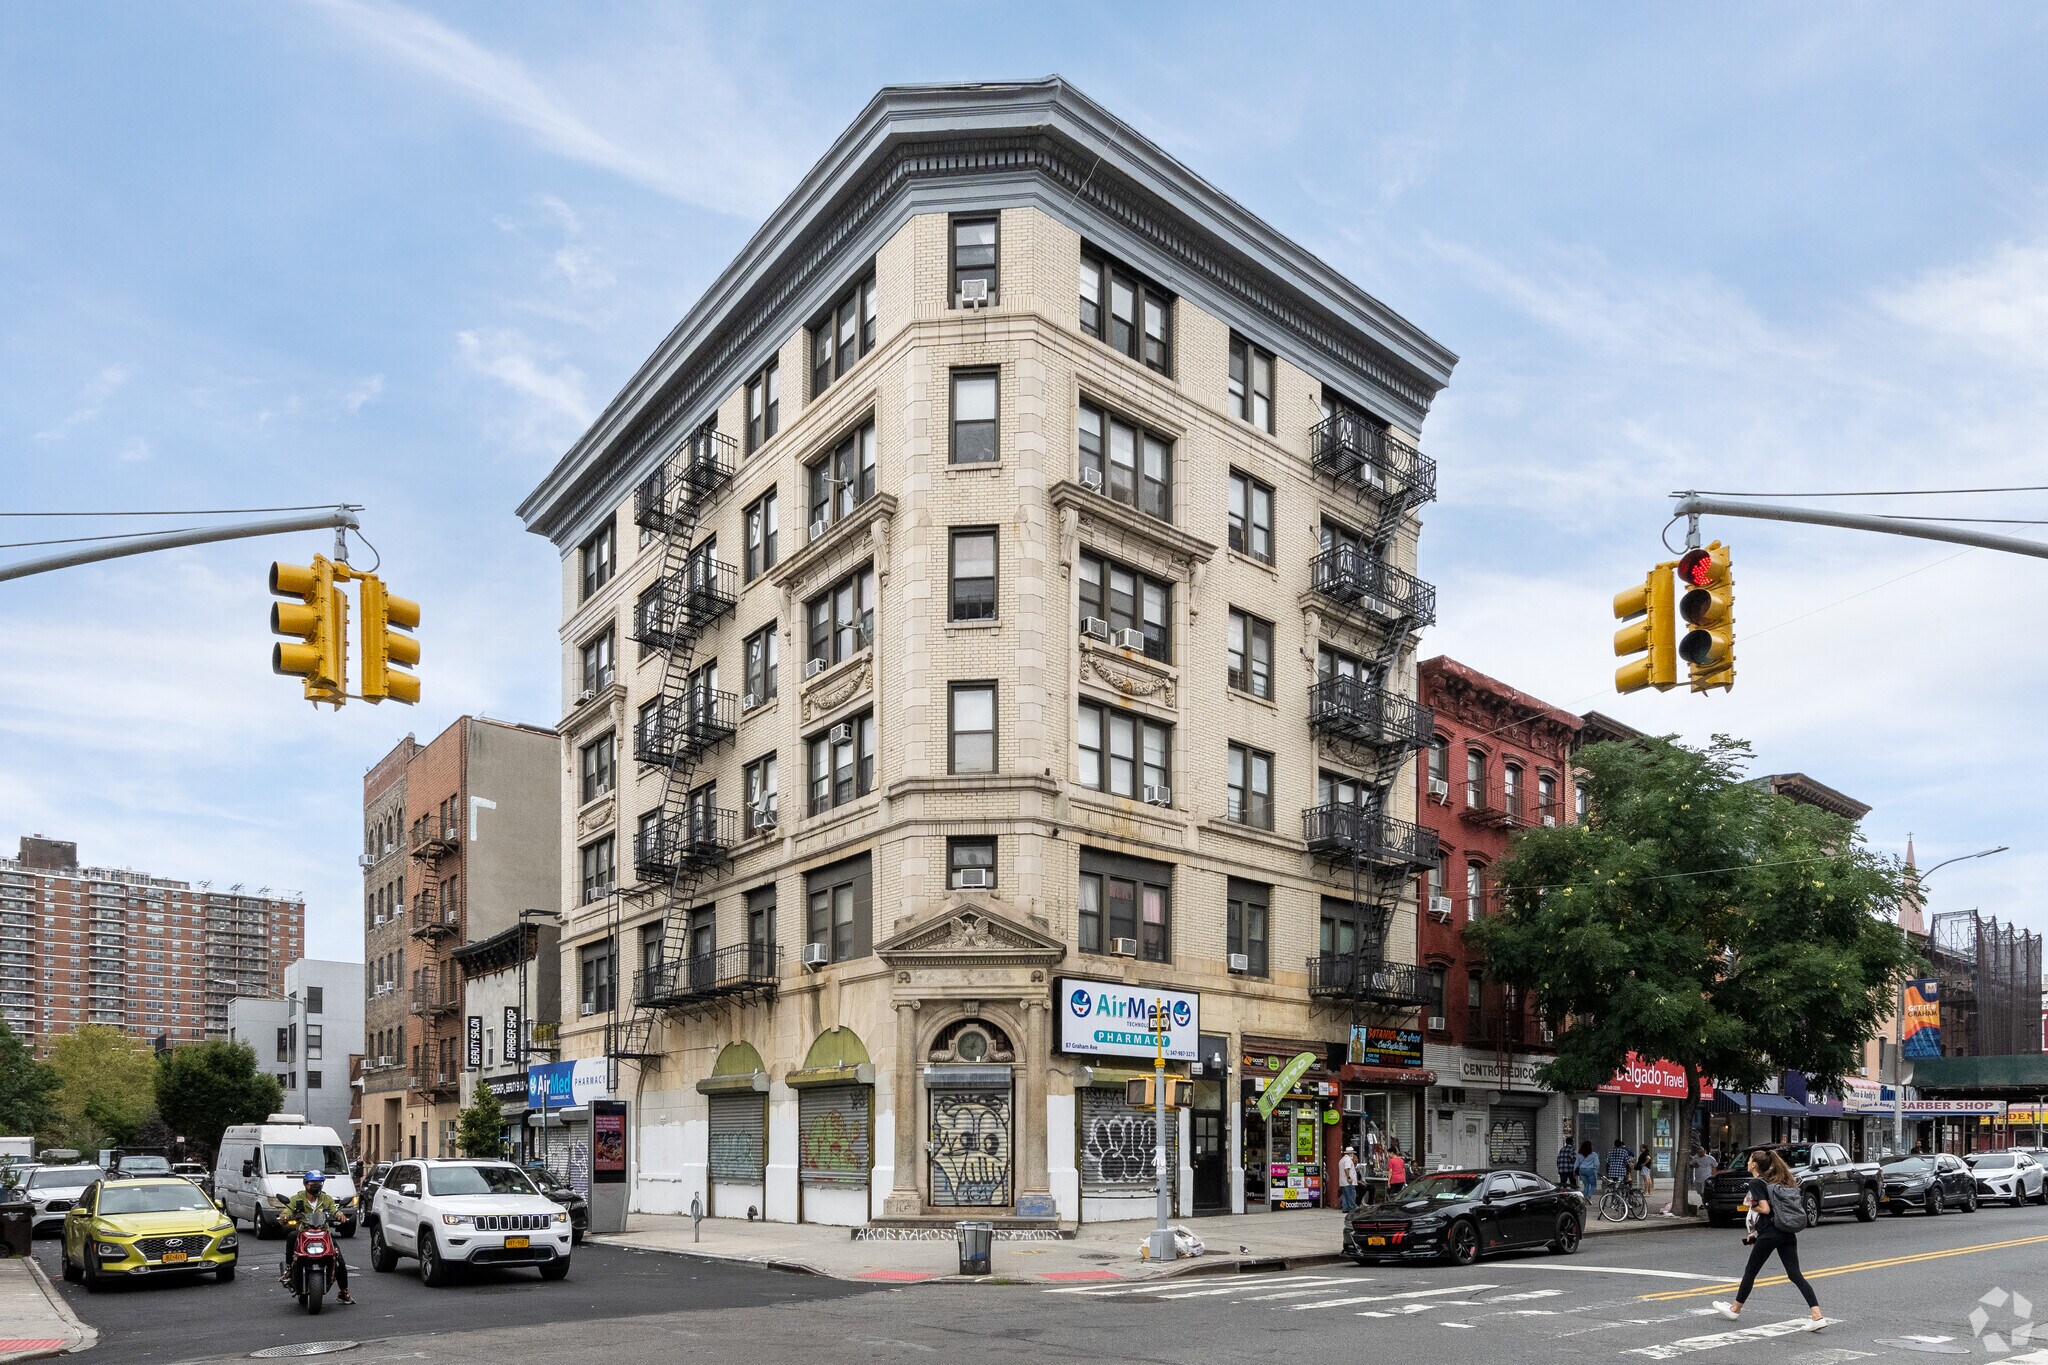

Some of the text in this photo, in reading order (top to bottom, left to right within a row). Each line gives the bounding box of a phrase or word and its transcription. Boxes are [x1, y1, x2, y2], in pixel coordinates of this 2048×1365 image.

[1095, 993, 1171, 1019] AirMed
[471, 1018, 480, 1064] BEAUTY SALON
[506, 1009, 516, 1058] BARBER SHOP
[1098, 1032, 1168, 1046] PHARMACY
[1368, 1028, 1397, 1040] BOTANICA
[1463, 1062, 1500, 1076] CENTRO
[537, 1071, 570, 1095] AirMed
[575, 1075, 606, 1086] PHARMACY
[1663, 1071, 1685, 1088] Travel
[1901, 1102, 1951, 1110] BARBER
[1955, 1102, 1994, 1110] SHOP
